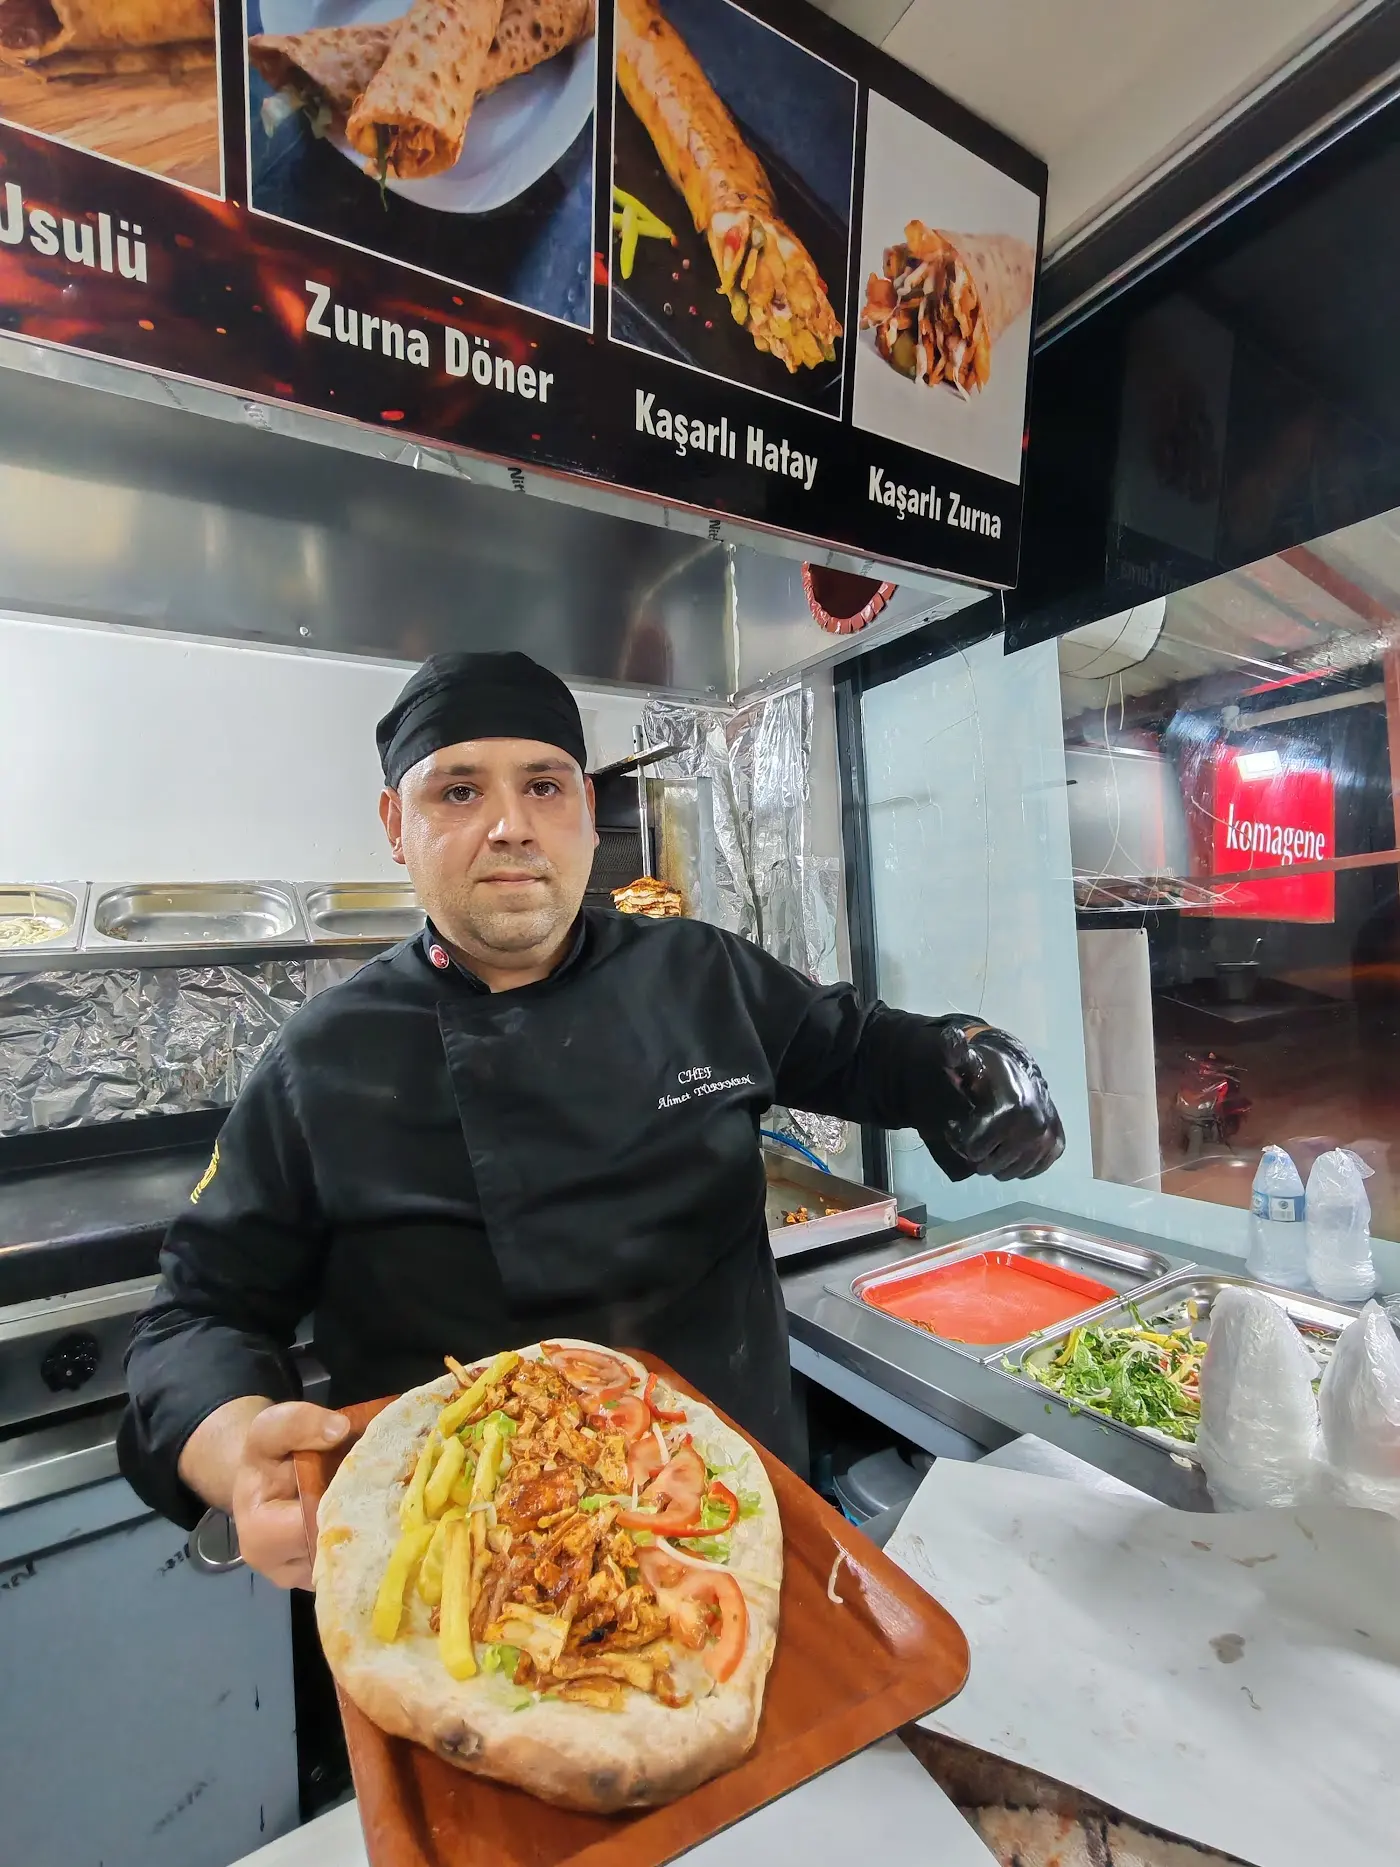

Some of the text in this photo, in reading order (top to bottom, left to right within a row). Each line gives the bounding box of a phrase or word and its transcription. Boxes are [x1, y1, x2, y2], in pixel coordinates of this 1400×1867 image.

[305, 279, 554, 403] Zurna Döner
[635, 389, 819, 491] Kaşarlı Hatay
[868, 465, 1003, 540] Kaşarlı Zurna
[1226, 803, 1325, 866] komagene
[658, 1092, 691, 1109] Ahmet
[678, 1066, 712, 1084] CHEF
